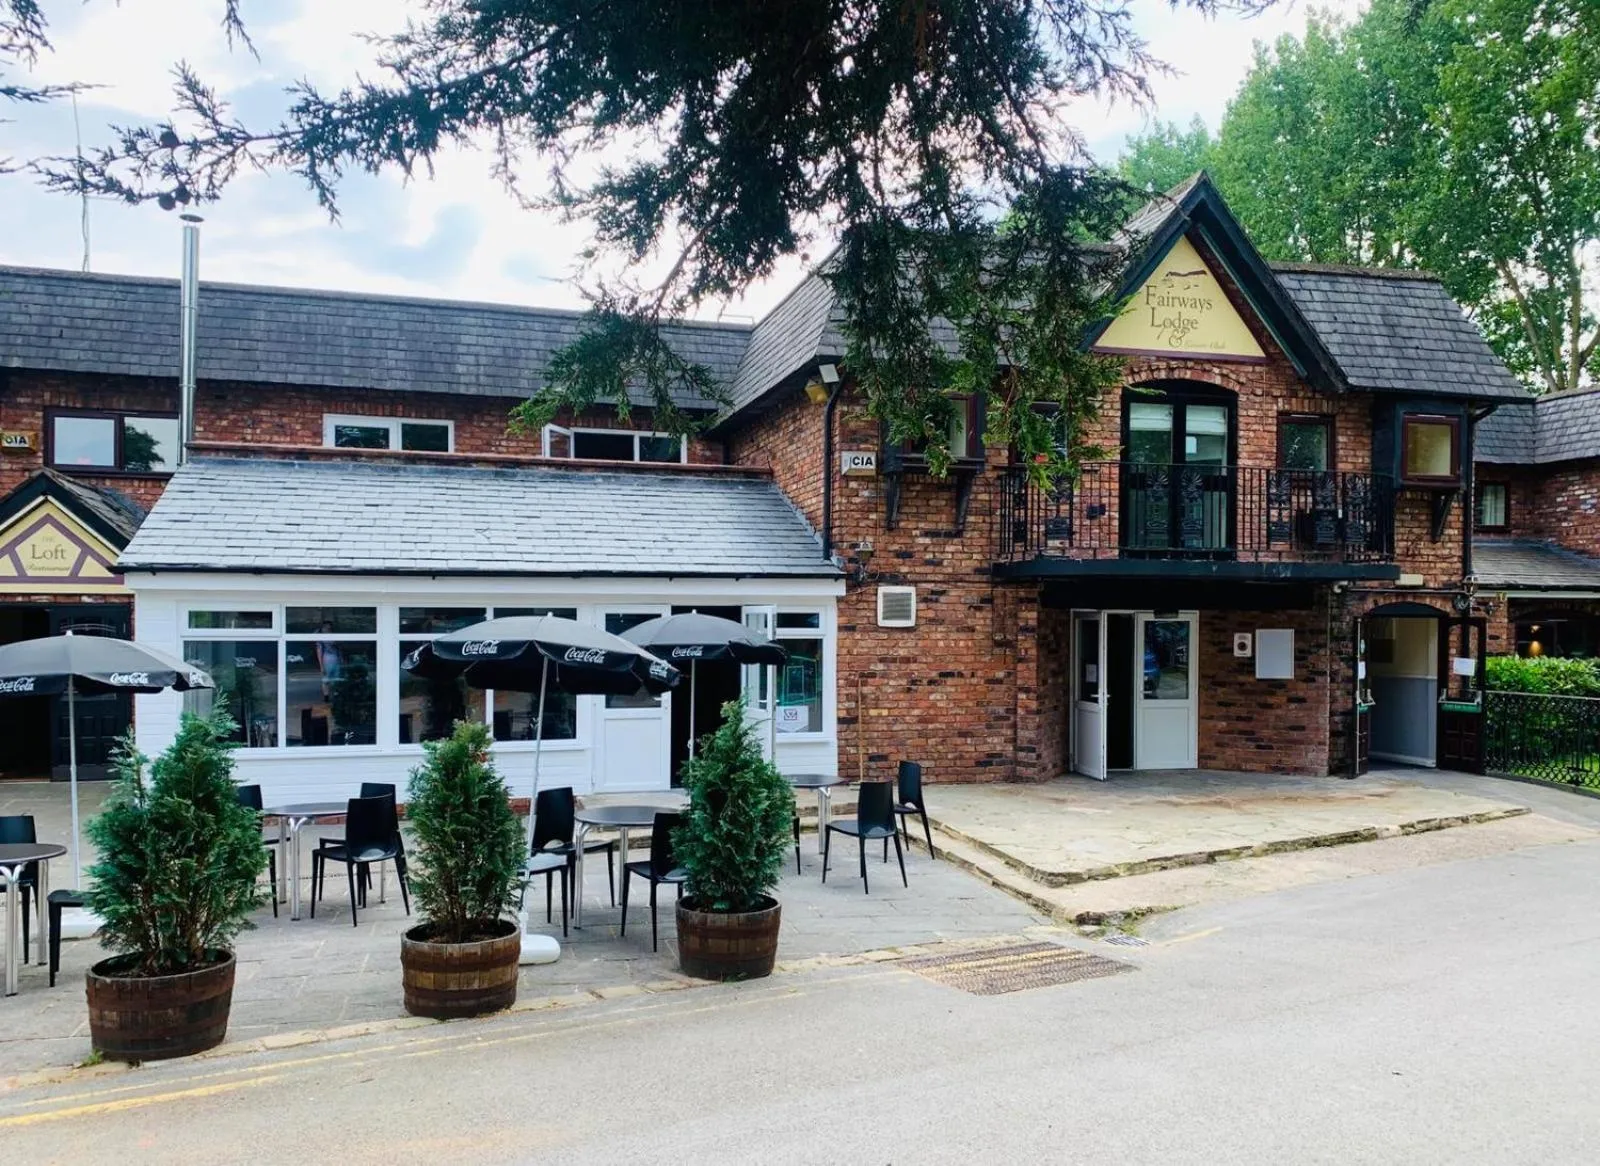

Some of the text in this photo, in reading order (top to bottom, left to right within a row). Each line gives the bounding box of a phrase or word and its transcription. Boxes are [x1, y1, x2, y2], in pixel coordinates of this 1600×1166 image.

[1145, 285, 1213, 313] Fairways
[1150, 306, 1199, 333] Lodge
[852, 456, 873, 466] CIA
[31, 543, 67, 560] Loft
